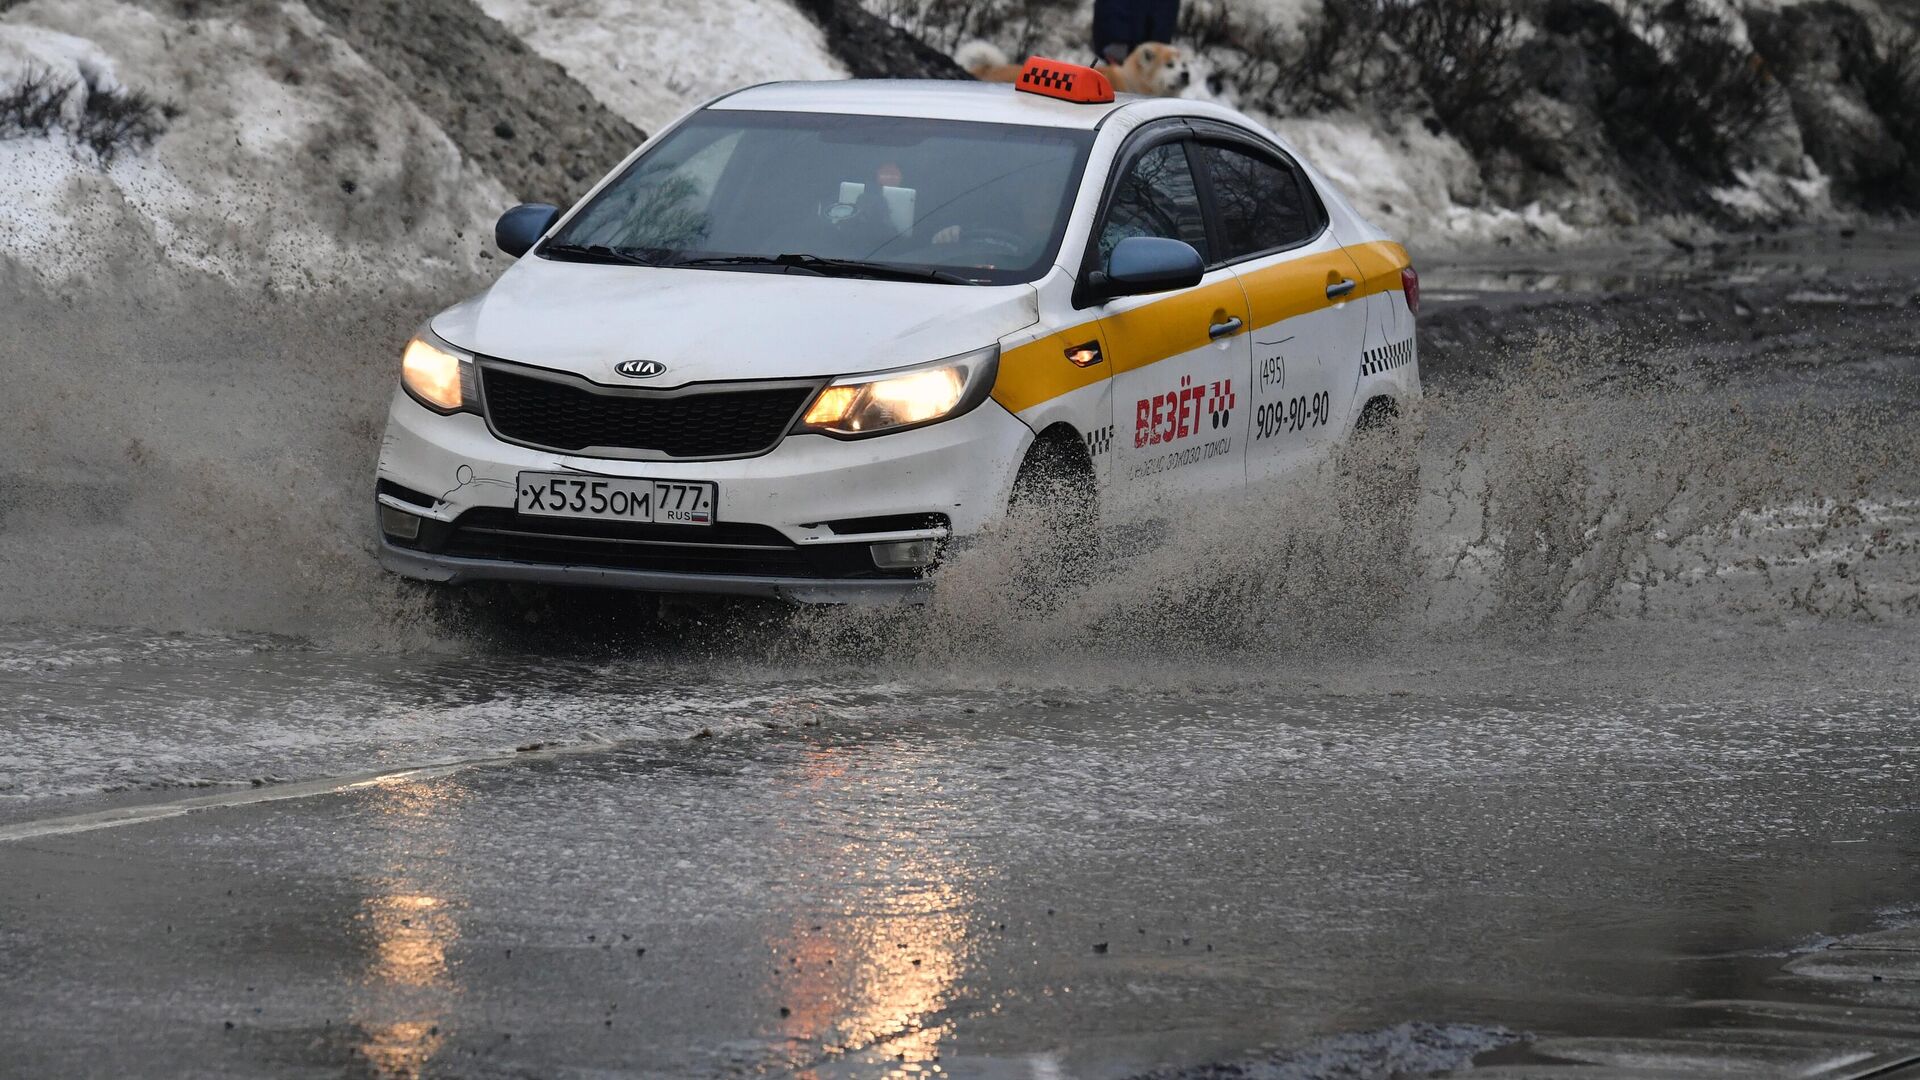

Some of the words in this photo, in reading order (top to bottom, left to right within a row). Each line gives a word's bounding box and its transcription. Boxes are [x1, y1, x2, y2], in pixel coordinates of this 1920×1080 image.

[622, 361, 655, 373] KIA
[1259, 355, 1286, 394] (495)
[1134, 374, 1206, 449] ВЕЗЁТ
[1256, 390, 1329, 441] 909-90-90
[656, 484, 703, 511] 777
[667, 511, 691, 521] RUS
